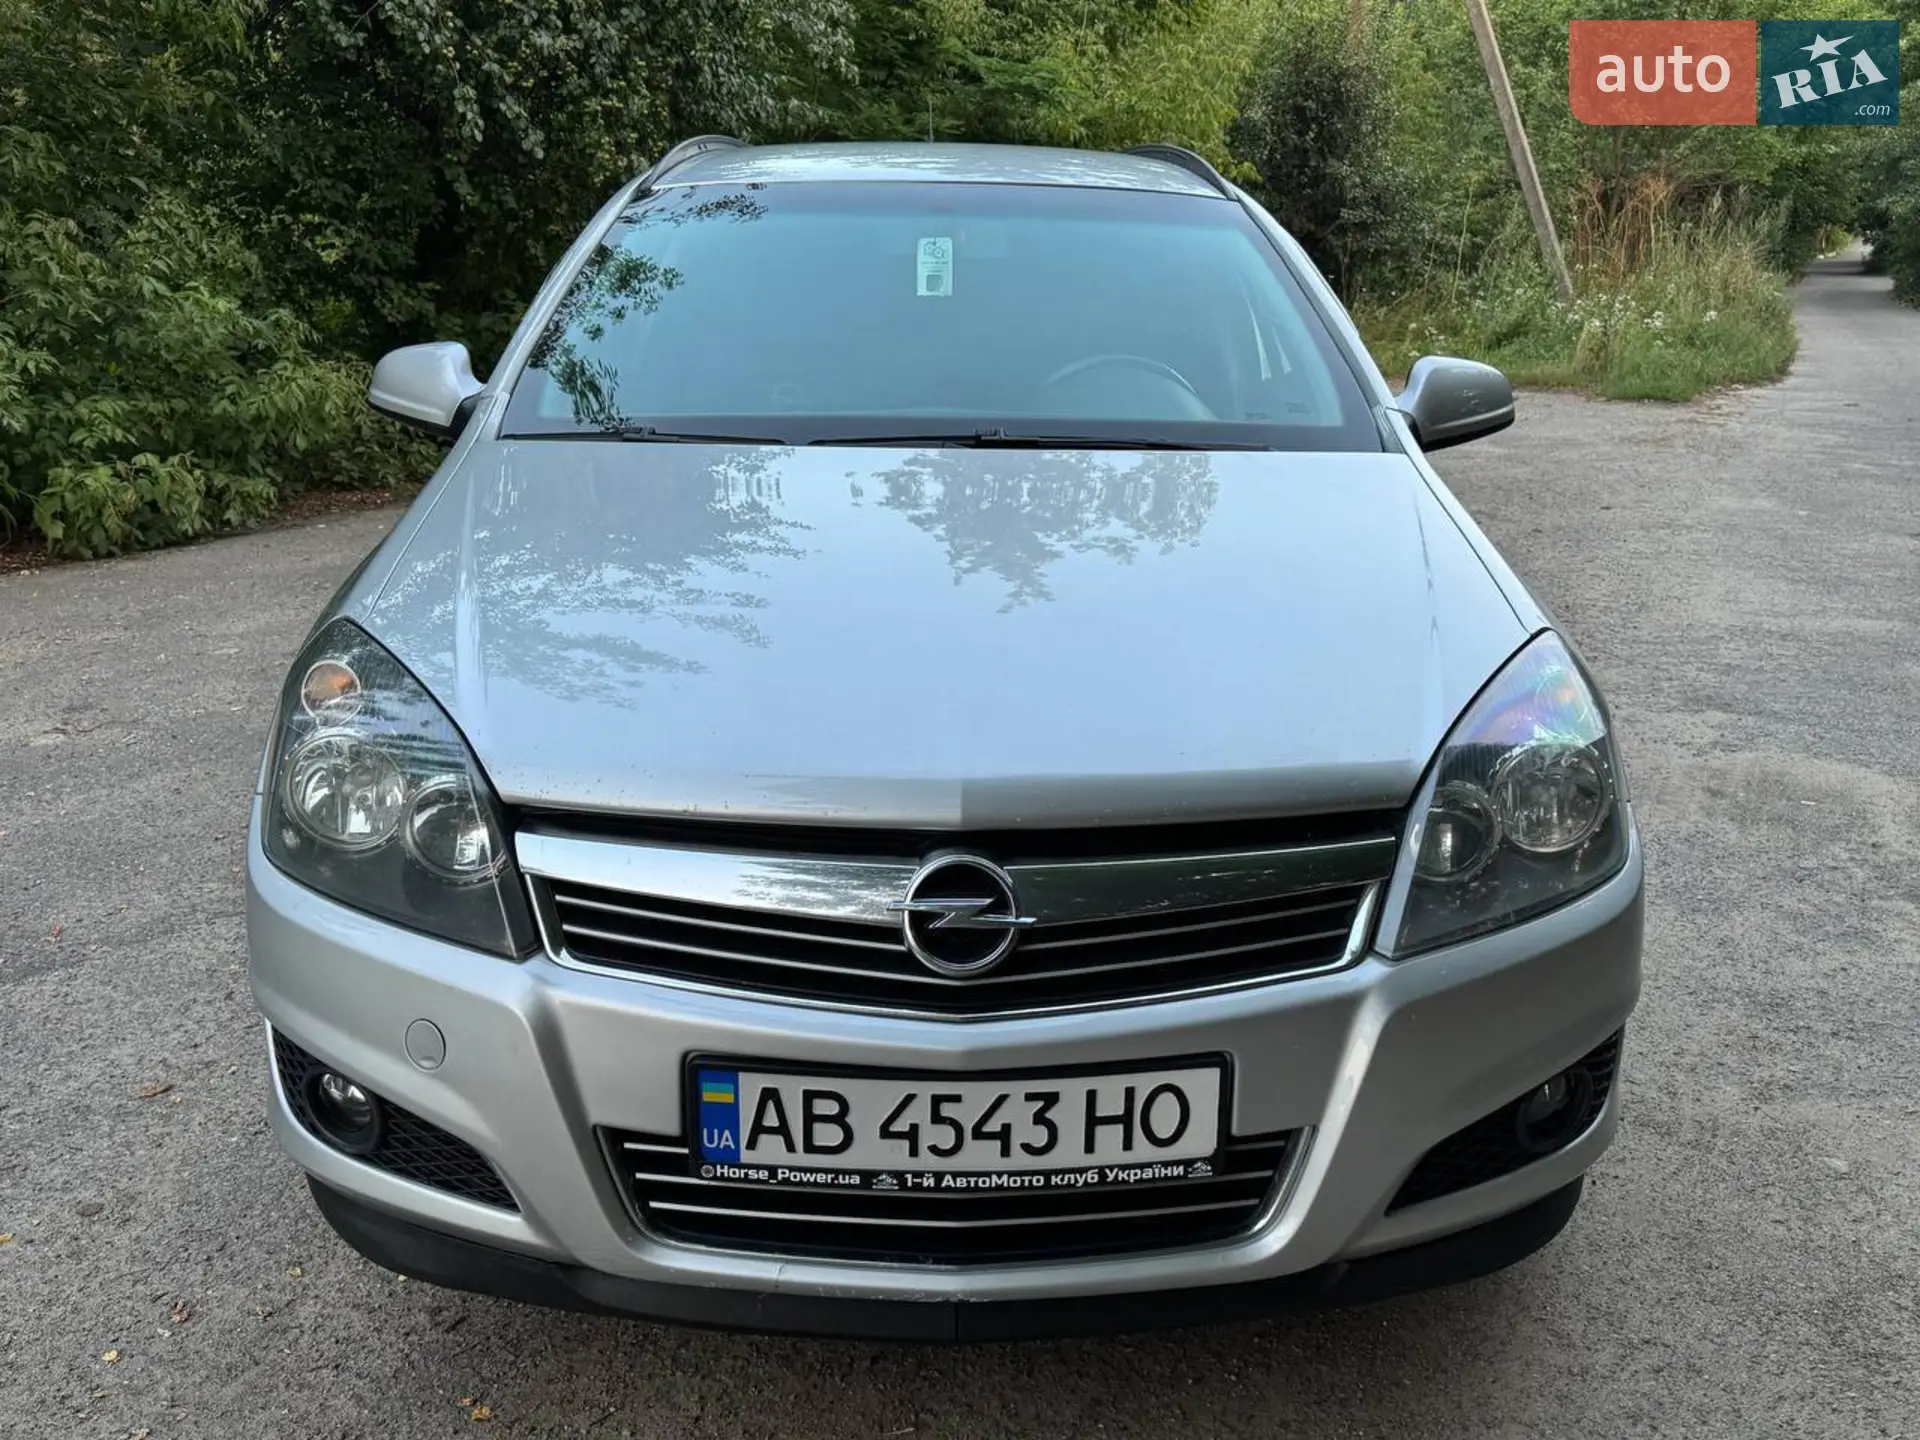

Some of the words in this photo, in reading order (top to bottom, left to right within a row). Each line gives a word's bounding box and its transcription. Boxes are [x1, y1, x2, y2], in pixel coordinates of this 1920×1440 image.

[745, 1087, 854, 1155] AB
[878, 1091, 1060, 1158] 4543
[1083, 1082, 1191, 1155] HO
[702, 1128, 735, 1150] UA
[716, 1164, 860, 1185] Horse_Power.ua
[904, 1173, 935, 1188] 1-й
[941, 1173, 1045, 1188] АвтоМото
[1051, 1169, 1099, 1187] клуб
[1105, 1164, 1185, 1182] України
